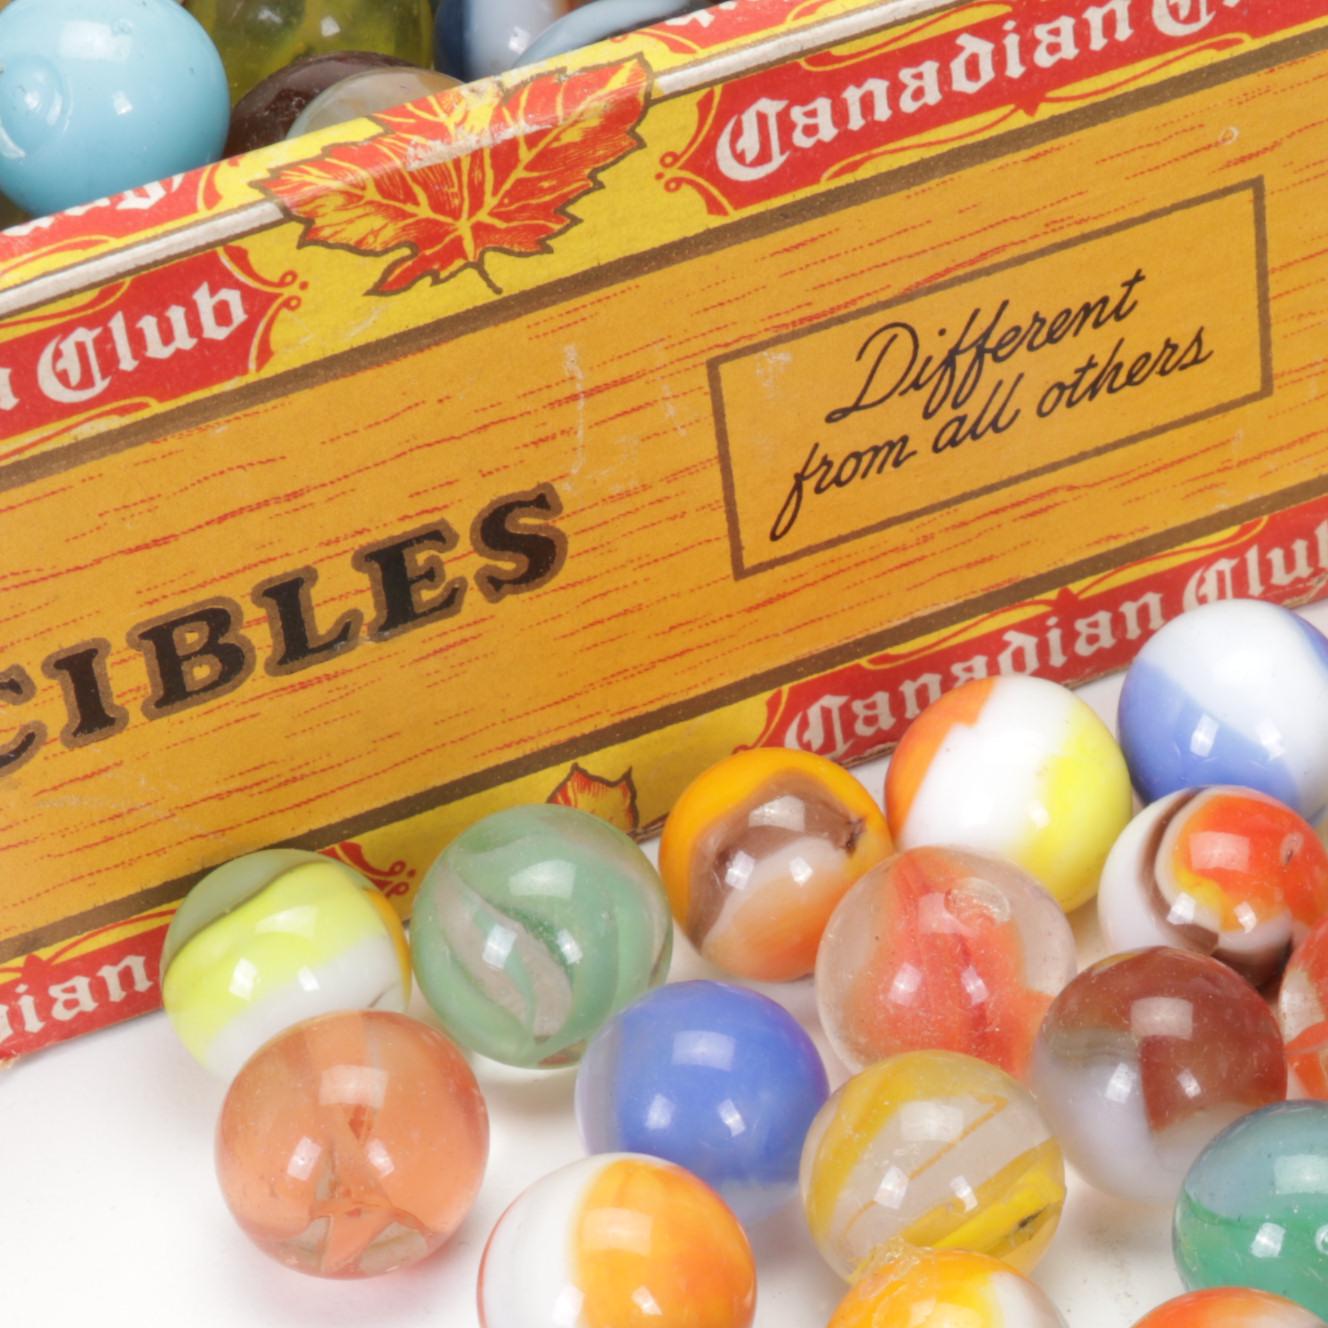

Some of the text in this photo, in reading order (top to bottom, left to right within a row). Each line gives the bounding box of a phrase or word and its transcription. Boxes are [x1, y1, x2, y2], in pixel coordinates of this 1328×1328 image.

[715, 0, 1134, 182] Canadian
[36, 281, 249, 405] Club
[825, 268, 1145, 424] Different
[769, 325, 1215, 541] from all others
